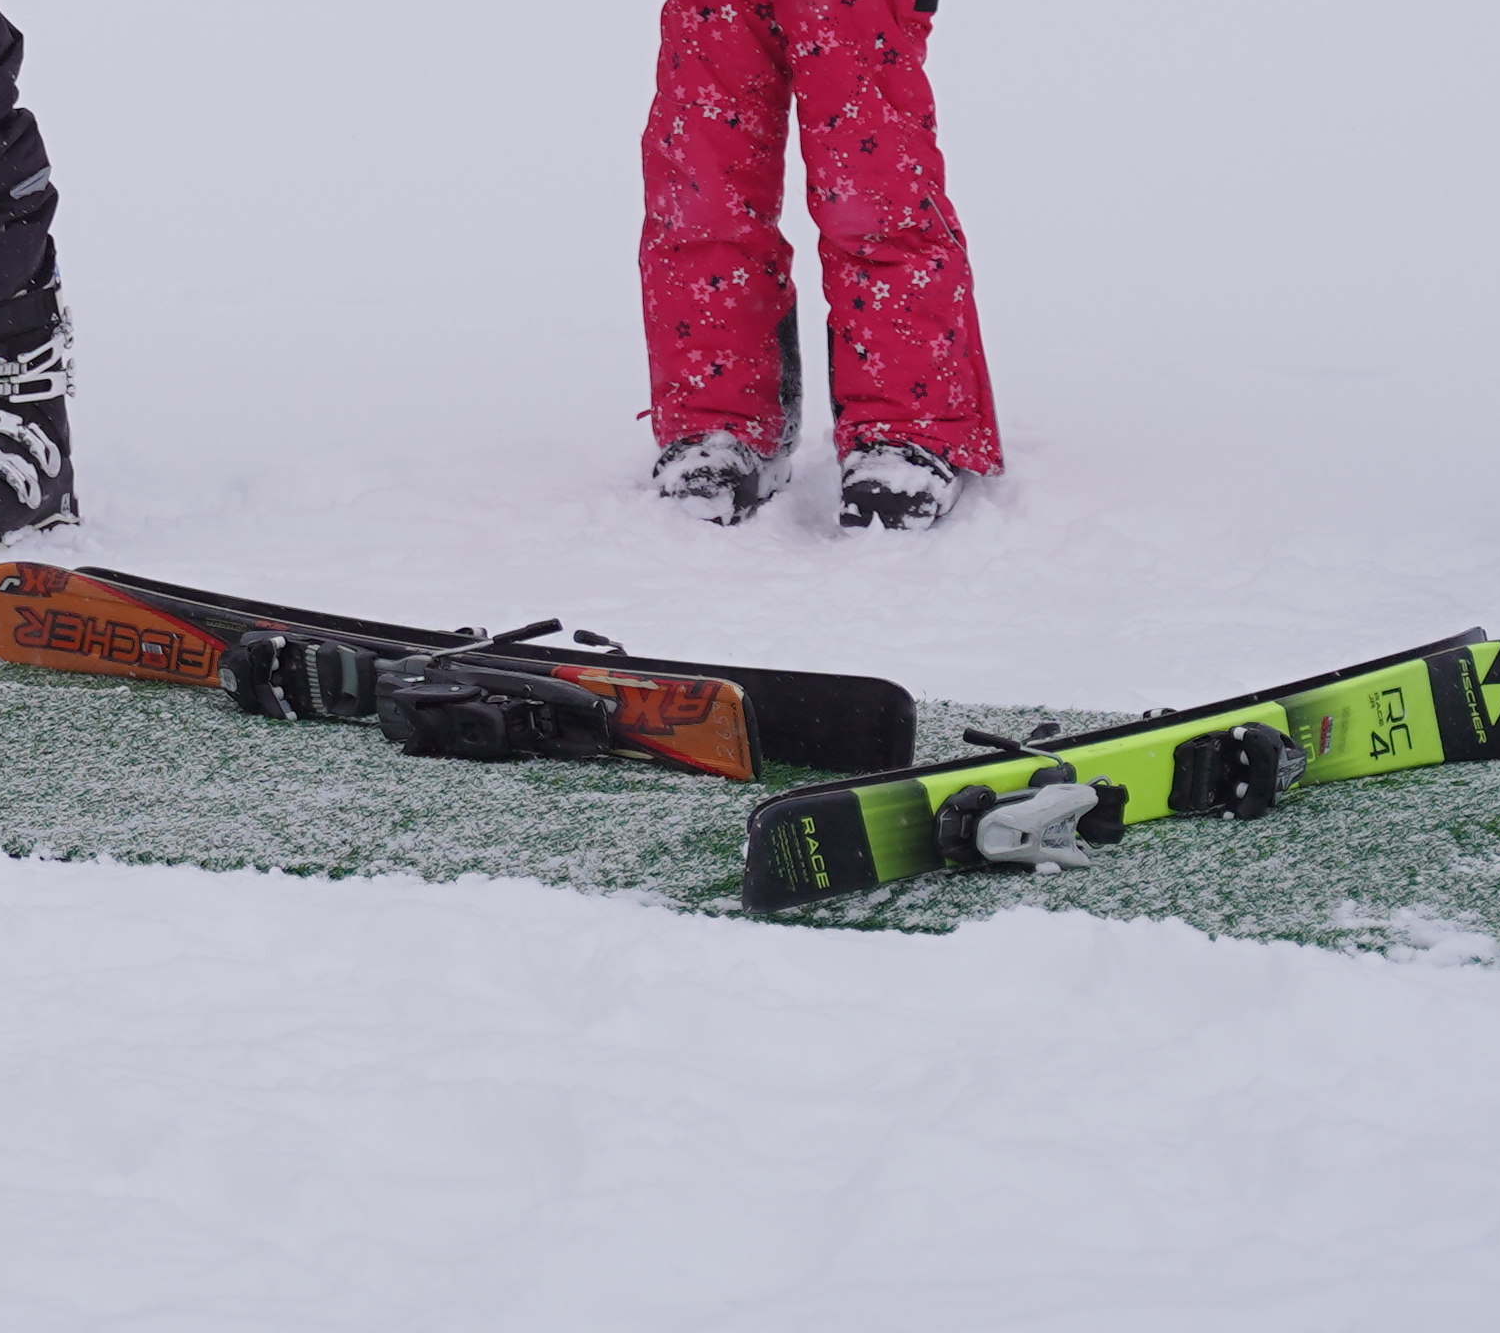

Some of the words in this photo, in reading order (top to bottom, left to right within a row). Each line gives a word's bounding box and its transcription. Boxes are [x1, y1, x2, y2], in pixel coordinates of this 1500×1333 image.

[14, 606, 214, 679] FISCHER
[1458, 658, 1488, 745] FISCHER
[800, 816, 832, 890] RACE
